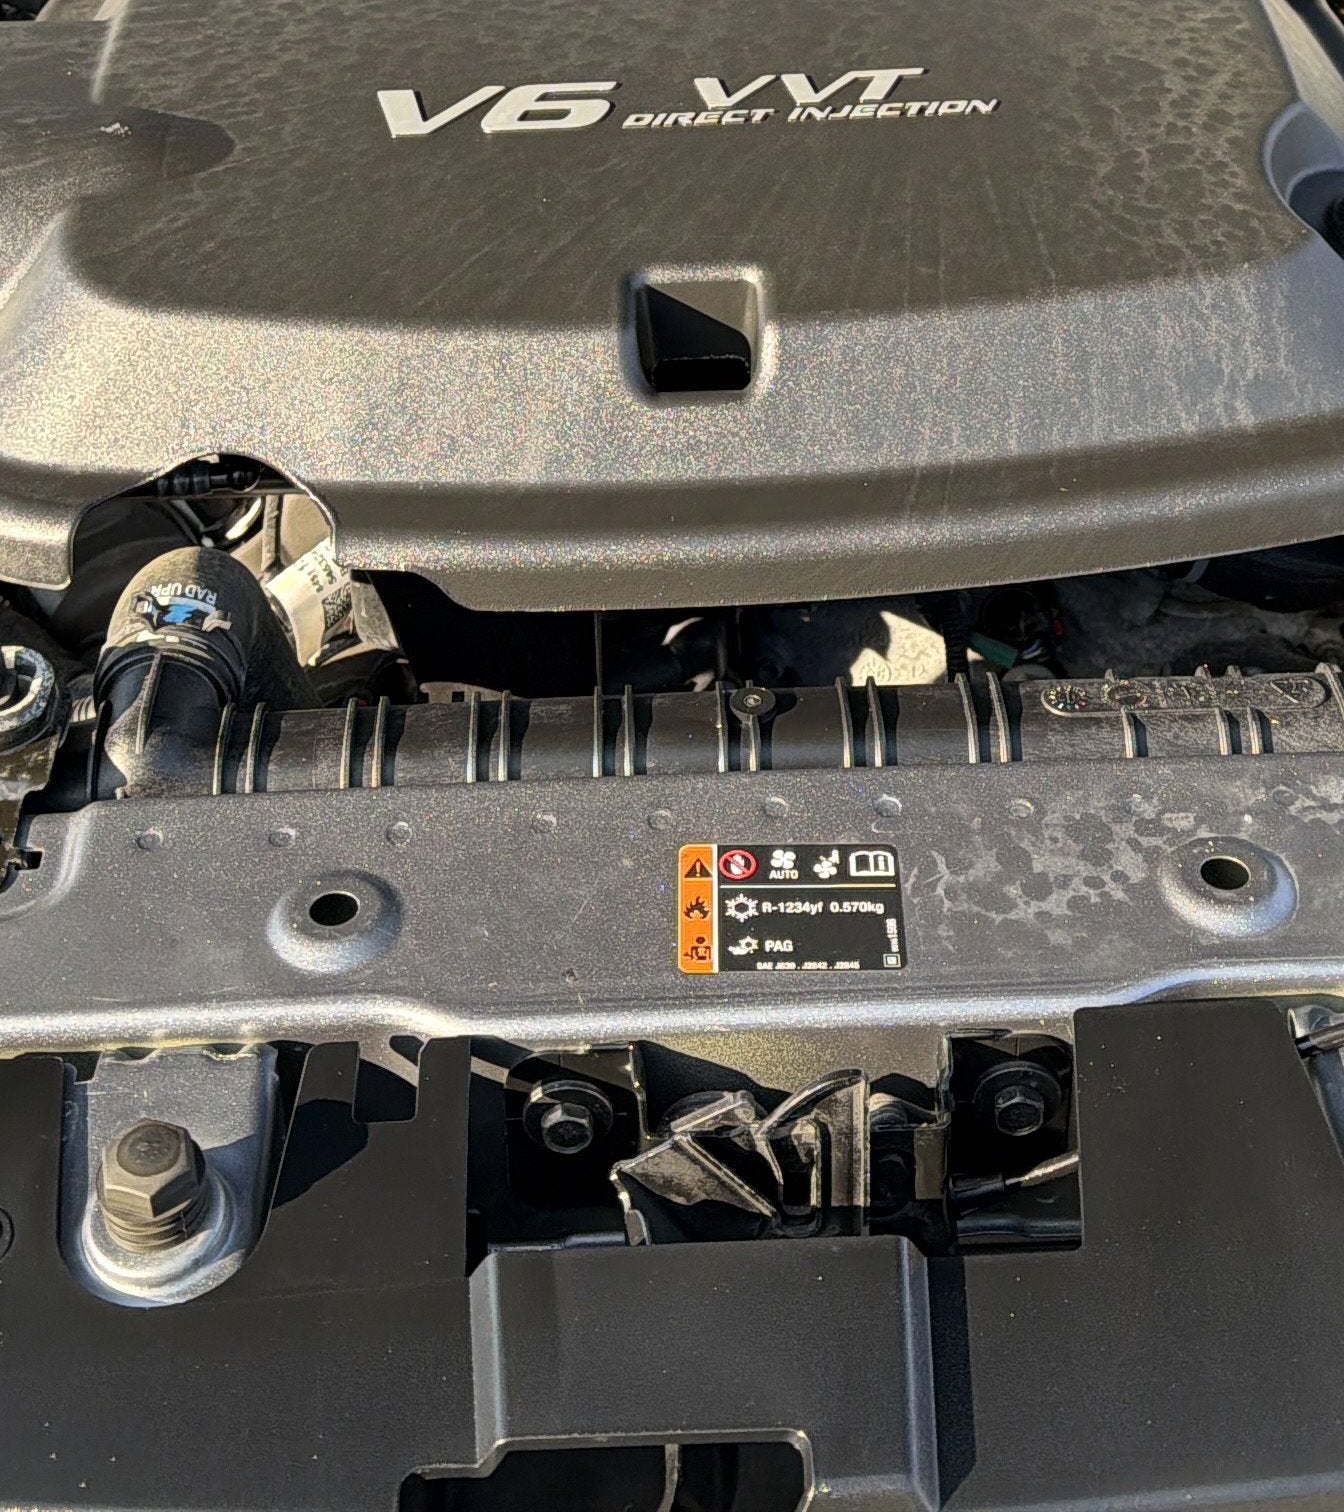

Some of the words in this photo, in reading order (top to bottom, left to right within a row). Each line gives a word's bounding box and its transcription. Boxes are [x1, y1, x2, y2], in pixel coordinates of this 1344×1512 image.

[693, 67, 926, 107] VVT
[377, 81, 620, 138] V6
[622, 108, 776, 129] DIRECT
[788, 99, 1000, 123] INJECTION
[185, 584, 217, 606] RAD
[769, 869, 798, 880] AUTO
[762, 901, 823, 915] R-1234yf
[830, 901, 885, 916] 0.570kg
[764, 939, 794, 952] PAG
